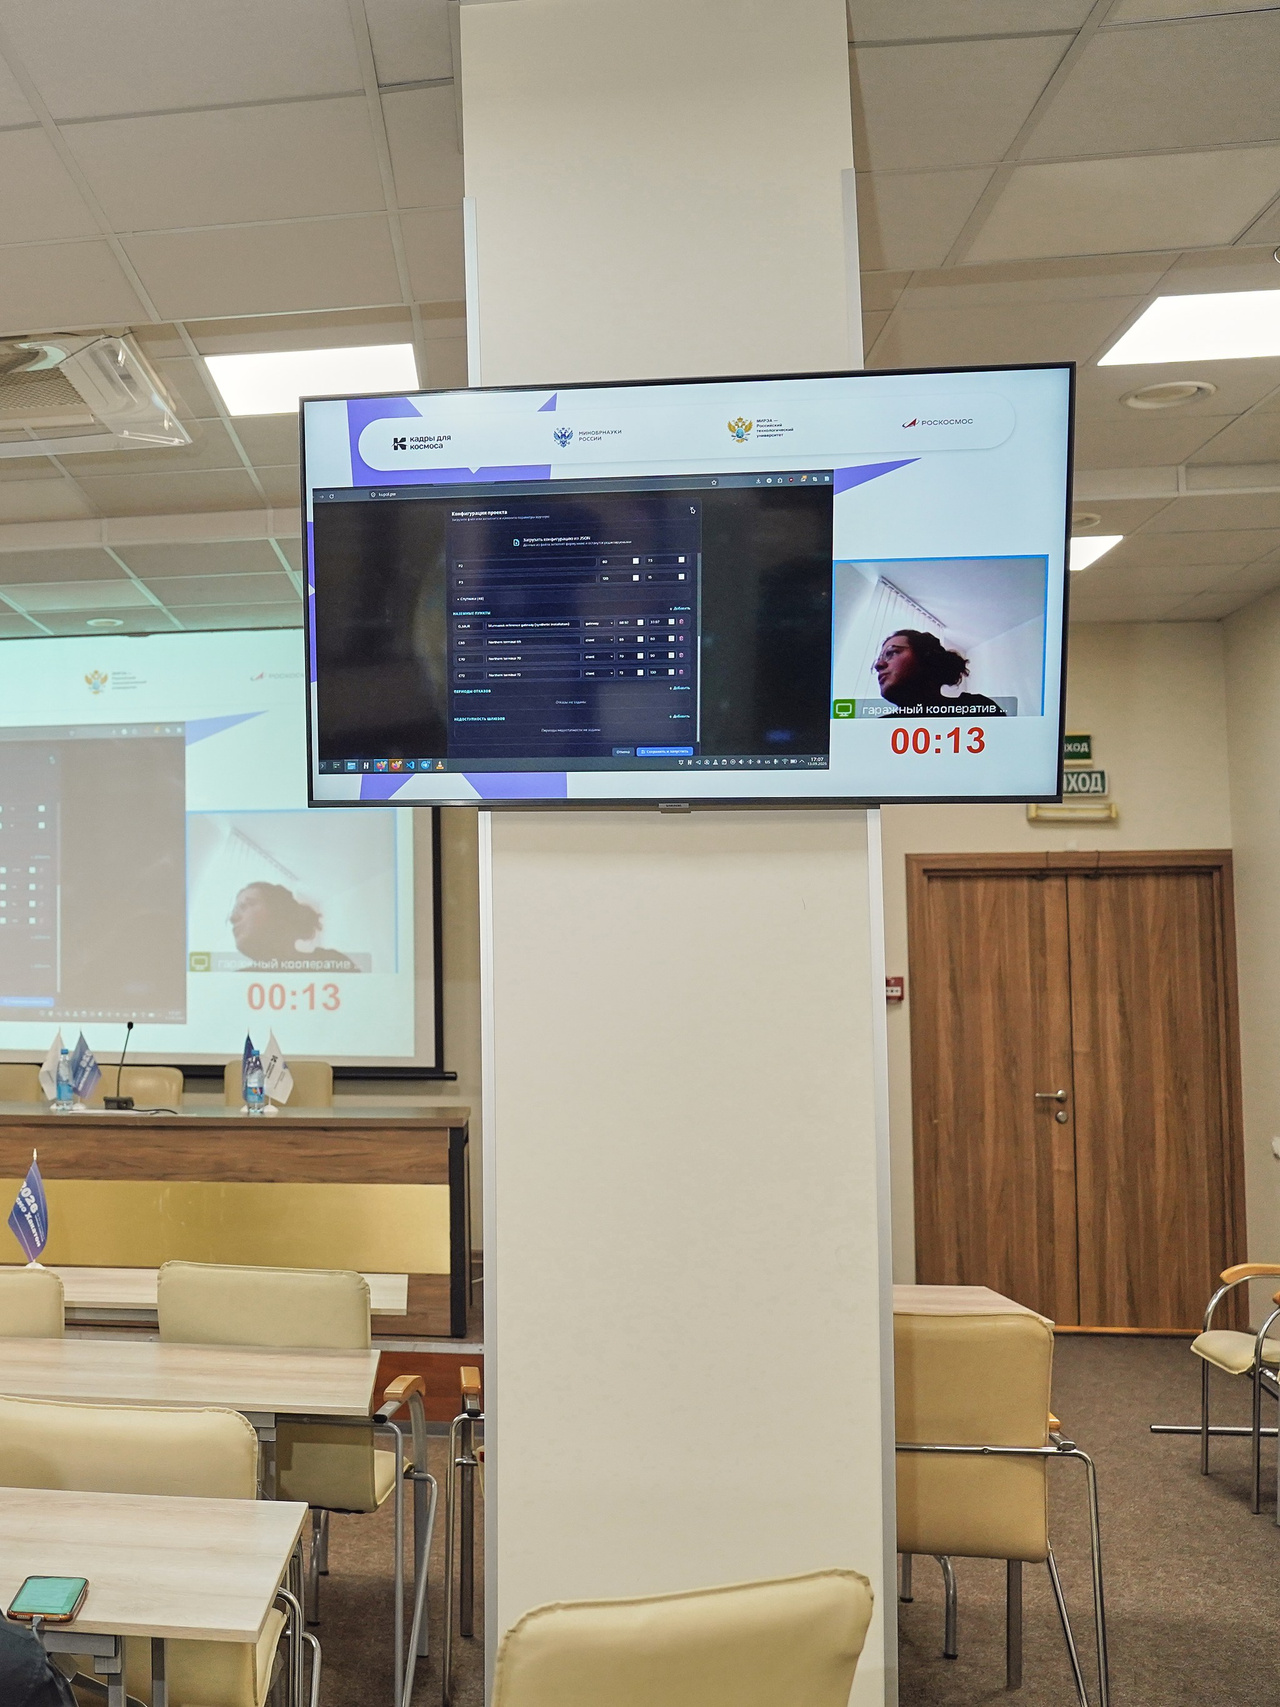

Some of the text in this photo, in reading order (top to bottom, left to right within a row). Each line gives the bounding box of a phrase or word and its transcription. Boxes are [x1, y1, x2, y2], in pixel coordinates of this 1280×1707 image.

[921, 418, 974, 426] РОСКОСМОС
[409, 434, 452, 444] кадры для
[409, 443, 444, 451] космоса
[862, 704, 923, 716] гаражный
[926, 704, 996, 715] кооператив
[890, 726, 986, 755] 00:13
[1064, 742, 1089, 753] ХОД
[1063, 773, 1103, 793] ХОД
[246, 982, 341, 1011] 00:13
